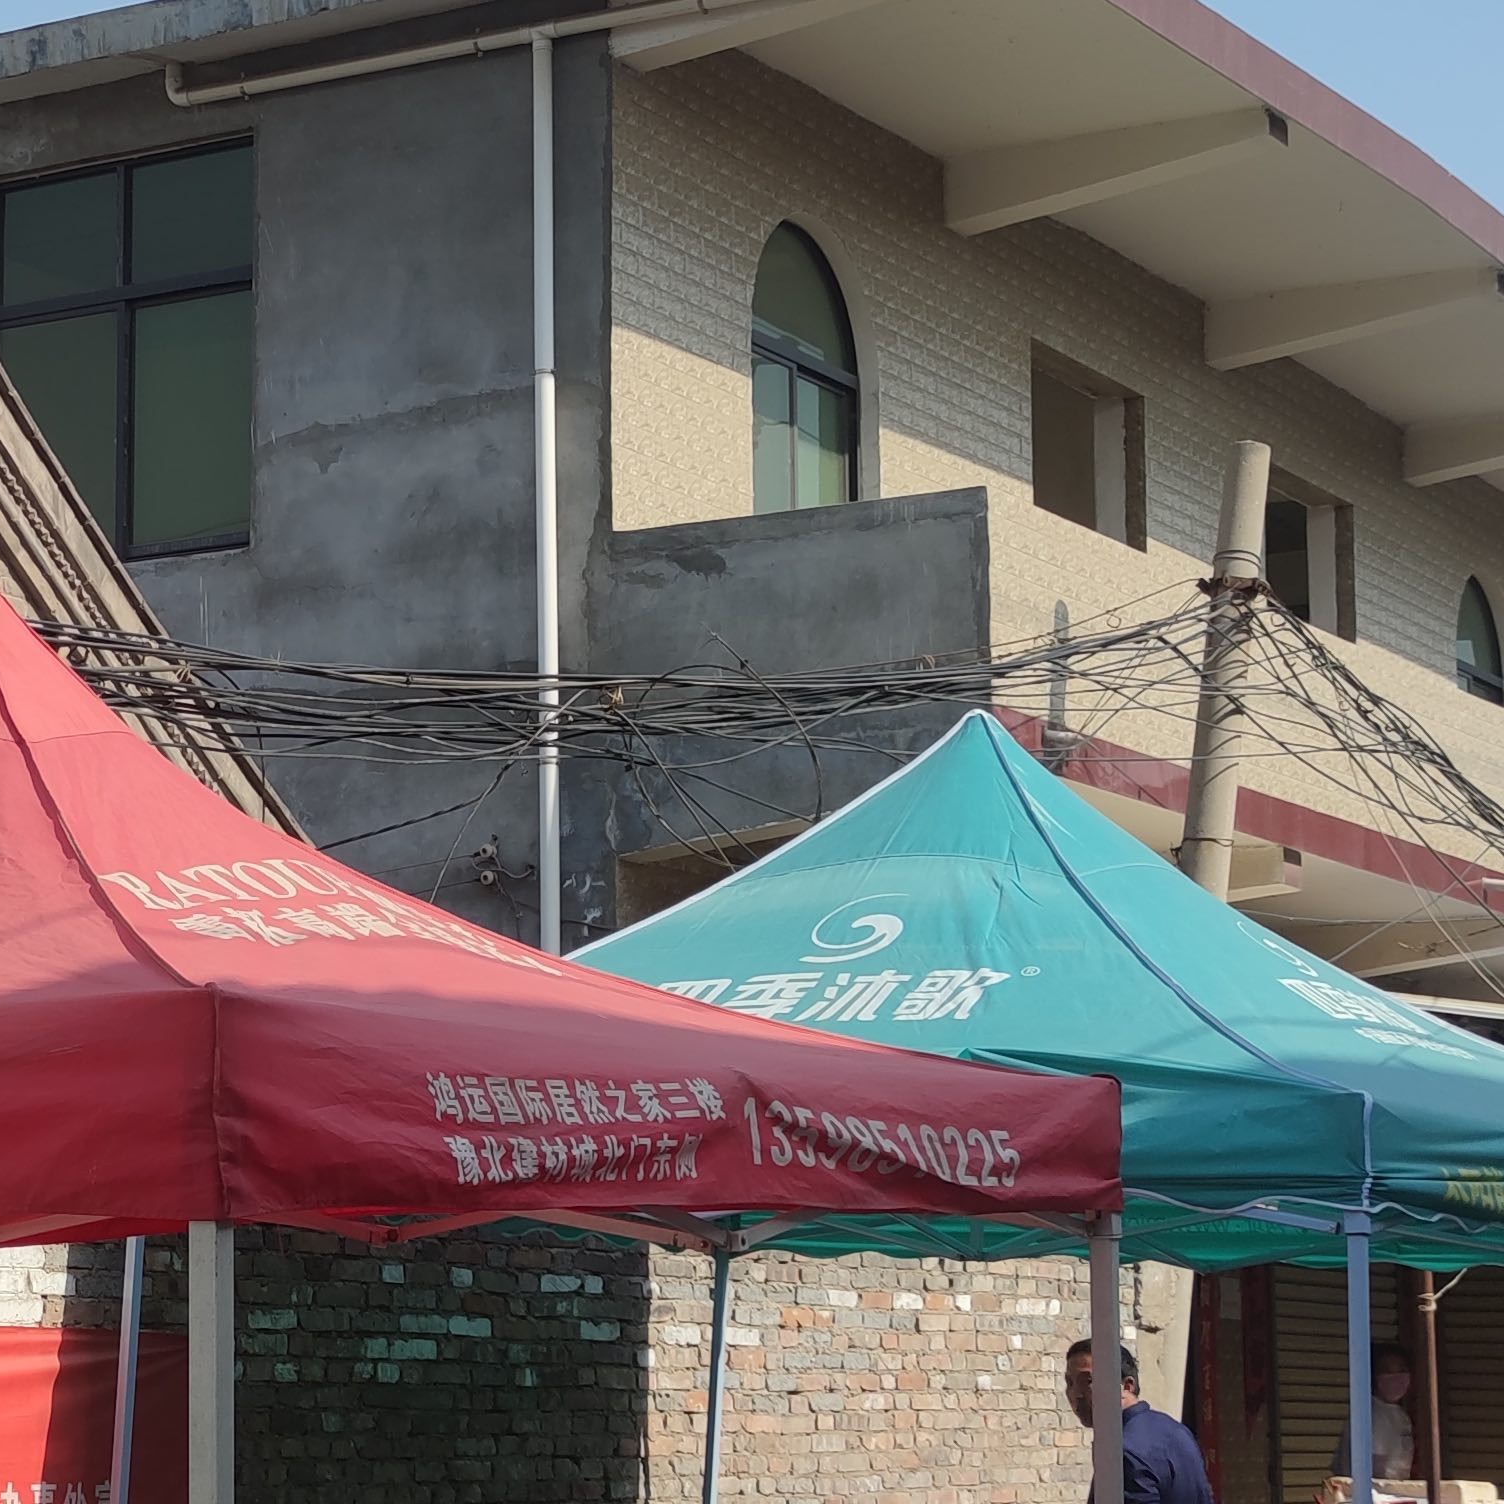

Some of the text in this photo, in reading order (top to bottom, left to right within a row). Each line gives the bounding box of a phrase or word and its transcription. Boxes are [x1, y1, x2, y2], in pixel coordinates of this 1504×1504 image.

[426, 1071, 728, 1127] 鸿运国际居然之家三楼
[443, 1132, 704, 1186] 豫北建材城北门东侧
[743, 1095, 1021, 1188] 13598510225
